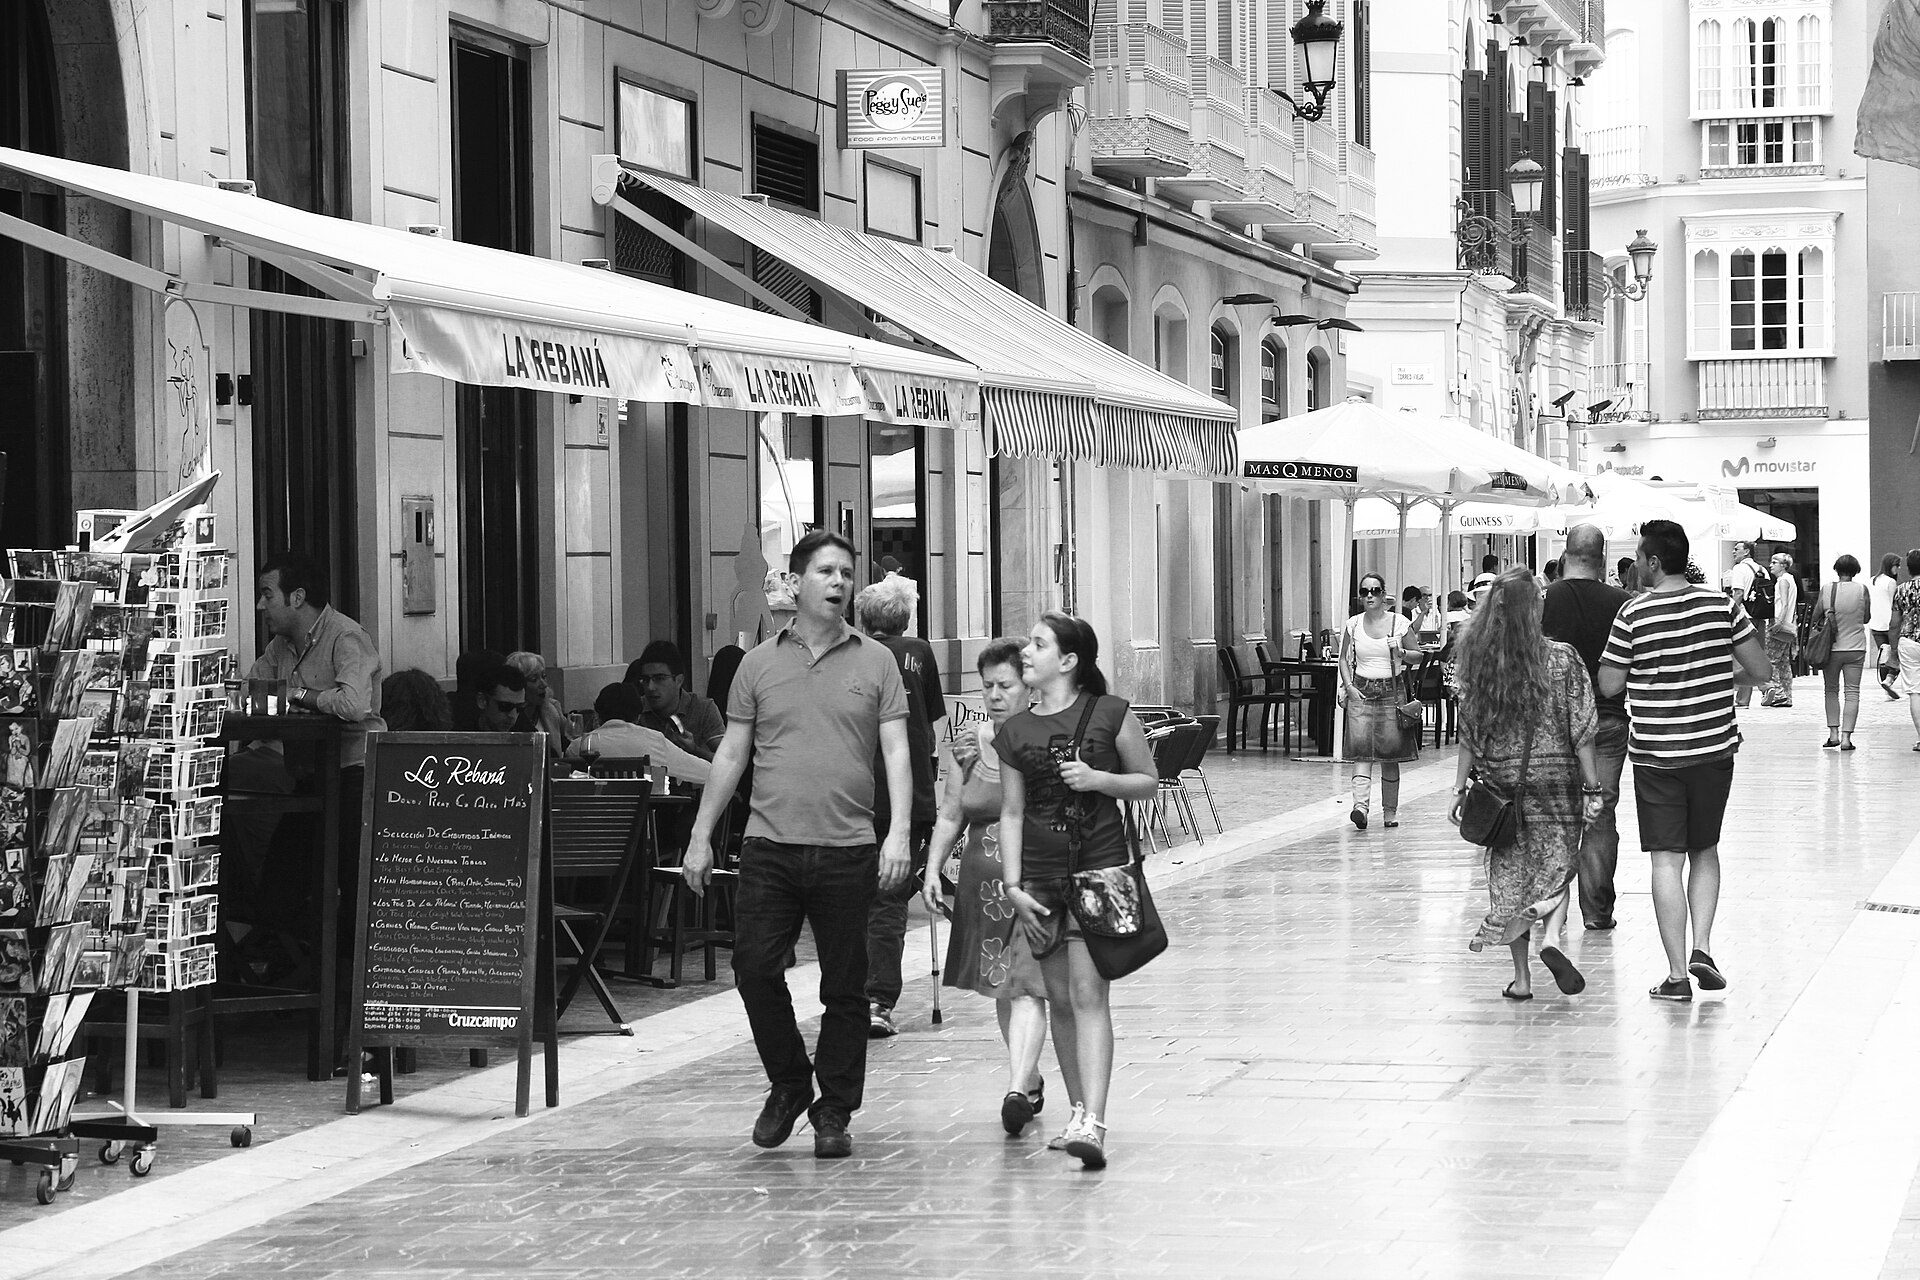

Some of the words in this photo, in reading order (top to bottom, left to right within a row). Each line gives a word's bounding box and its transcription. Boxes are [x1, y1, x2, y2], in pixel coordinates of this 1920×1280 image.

[864, 89, 899, 117] Peggy
[899, 87, 927, 115] Sue's
[853, 135, 875, 143] FOOD
[503, 333, 535, 386] LA
[531, 337, 615, 390] REBANÁ
[744, 366, 768, 404] LA
[764, 363, 821, 409] REBANÁ
[894, 384, 910, 419] LA
[909, 381, 951, 422] REBANÁ
[1754, 461, 1817, 473] movistar
[1459, 515, 1503, 527] GUINNESS
[403, 755, 440, 789] La
[443, 756, 508, 786] Rebaná
[448, 1012, 517, 1031] Cruzcampo
